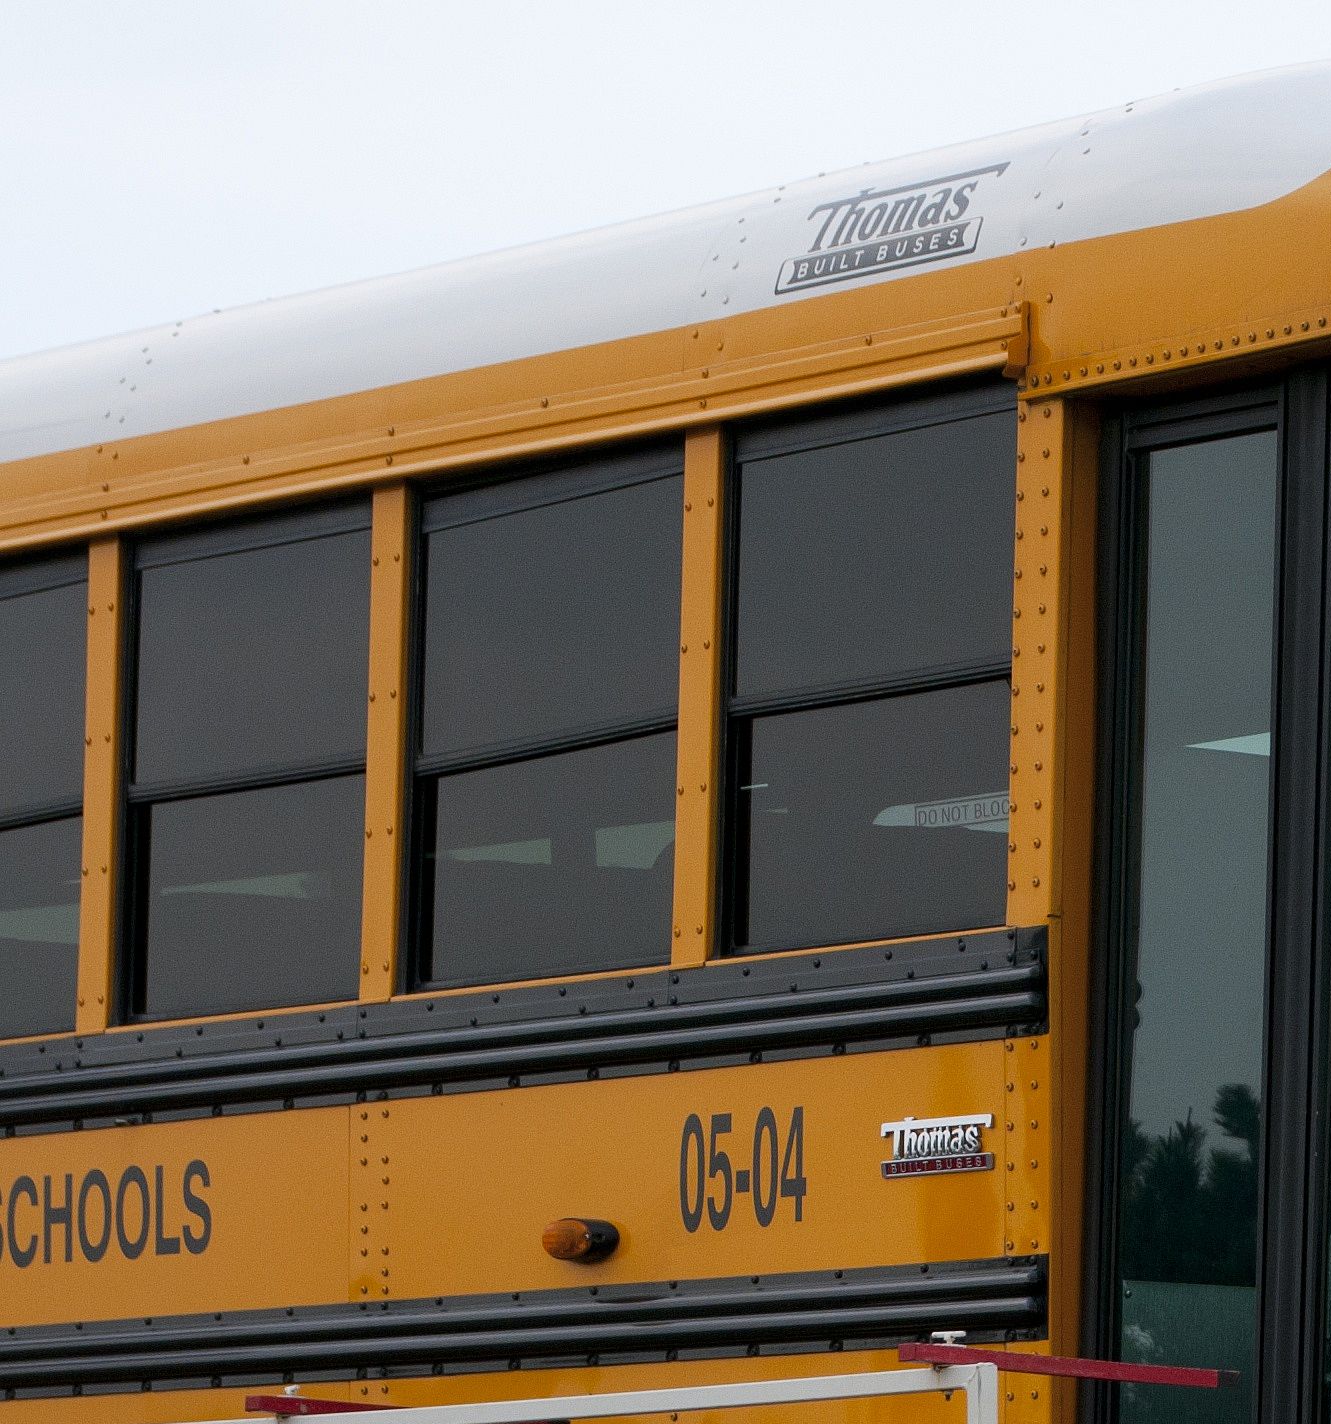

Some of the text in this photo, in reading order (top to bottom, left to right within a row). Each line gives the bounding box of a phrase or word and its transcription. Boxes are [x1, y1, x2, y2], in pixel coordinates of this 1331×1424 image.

[807, 160, 1012, 254] Thomas
[796, 228, 960, 280] BUILT BUSES
[917, 798, 1009, 827] DO NOT BLOC
[880, 1113, 994, 1161] Thomas
[679, 1105, 808, 1234] 05-04
[890, 1160, 930, 1175] BUILT
[0, 1158, 213, 1270] CHOOLS
